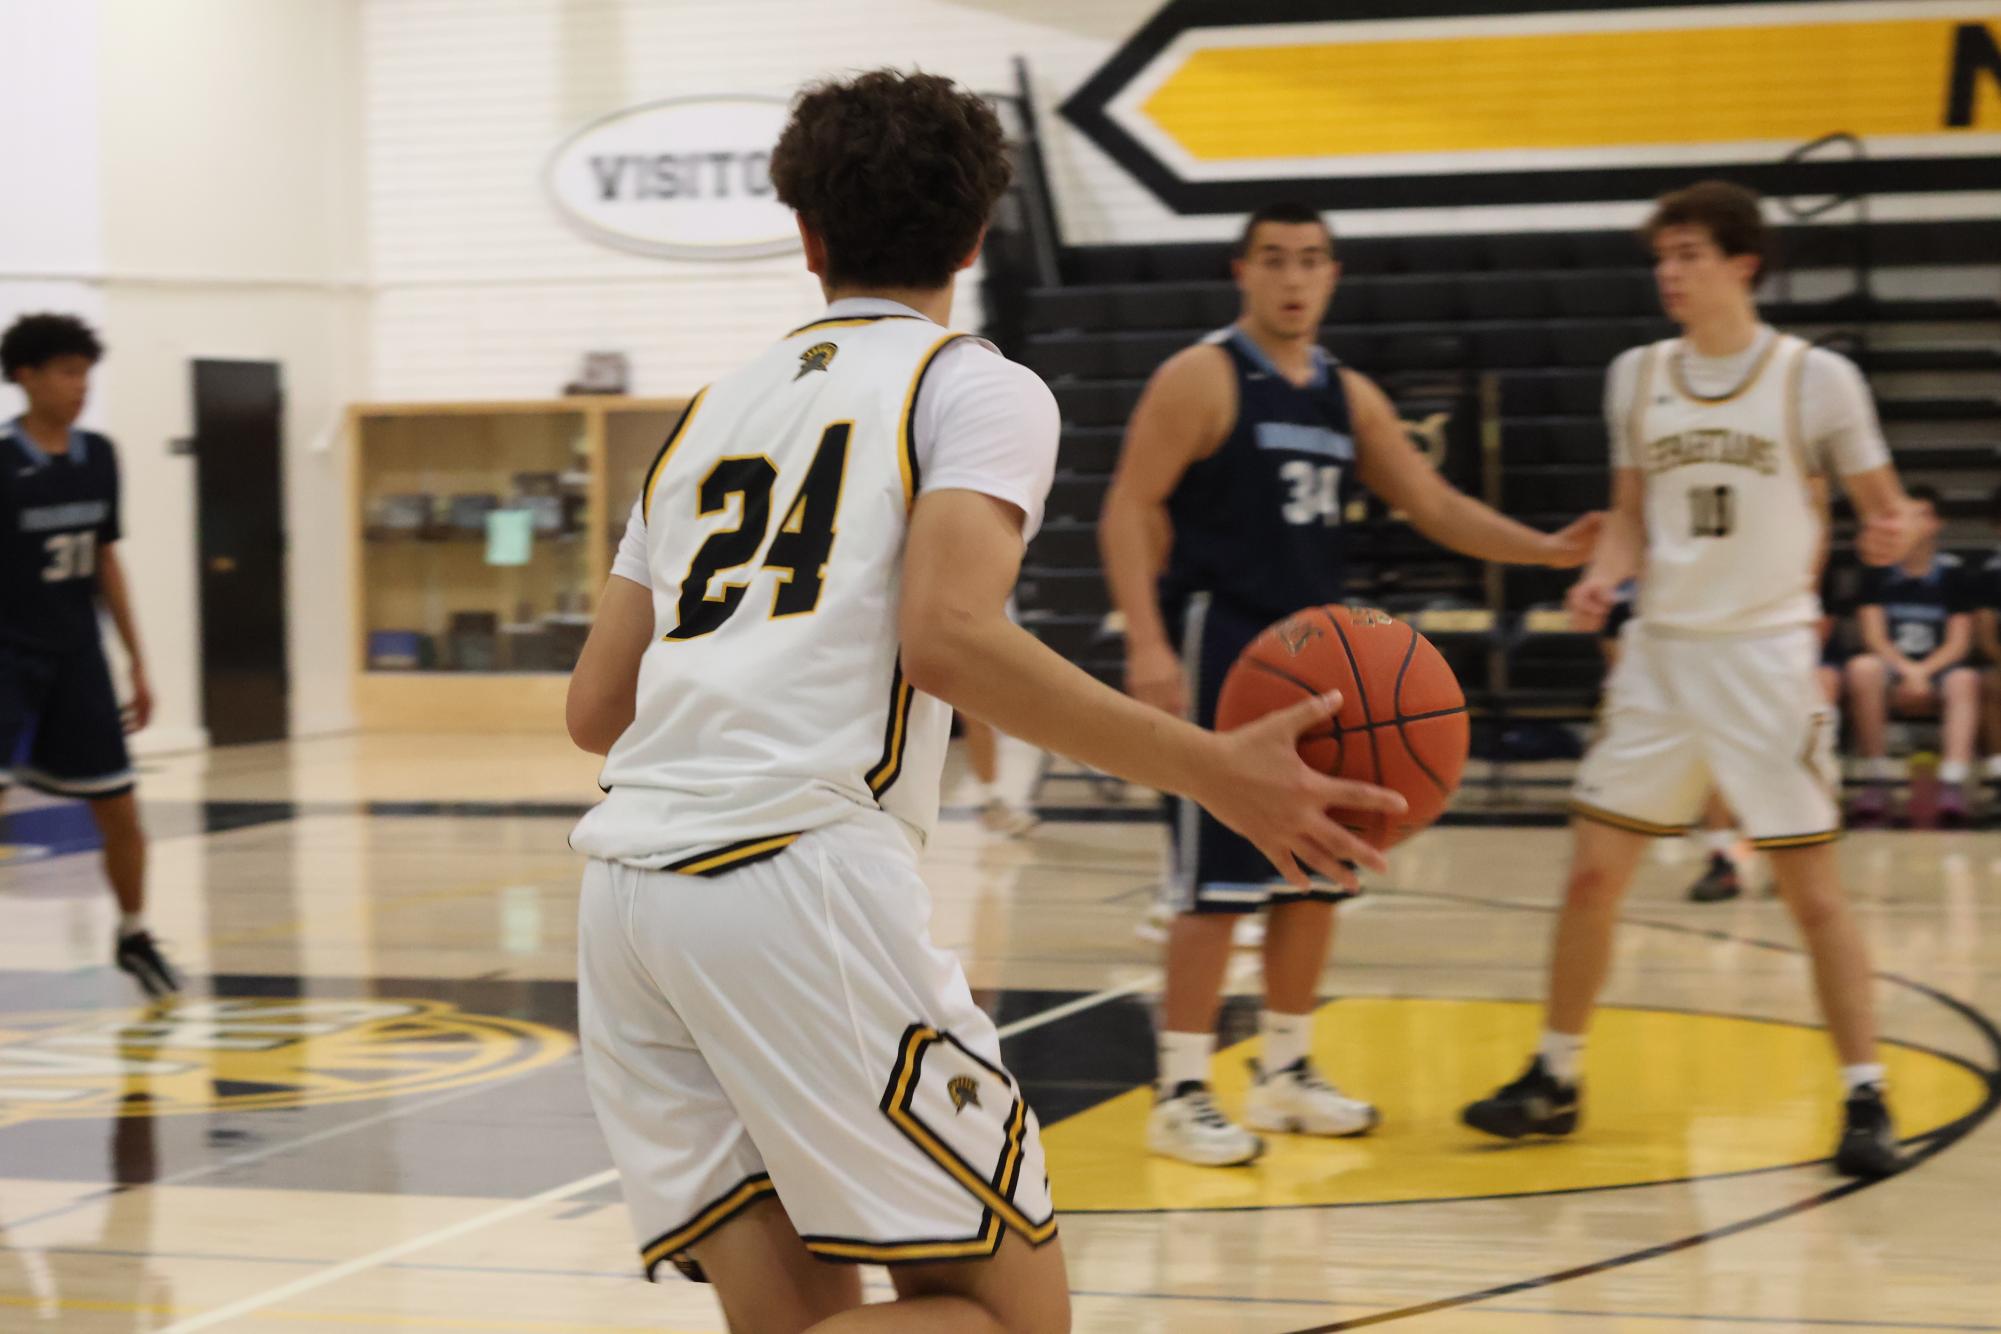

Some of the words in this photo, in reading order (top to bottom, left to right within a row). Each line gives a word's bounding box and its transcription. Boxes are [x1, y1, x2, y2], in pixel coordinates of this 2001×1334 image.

[1280, 460, 1342, 526] 34
[41, 532, 97, 581] 31
[662, 419, 855, 642] 24
